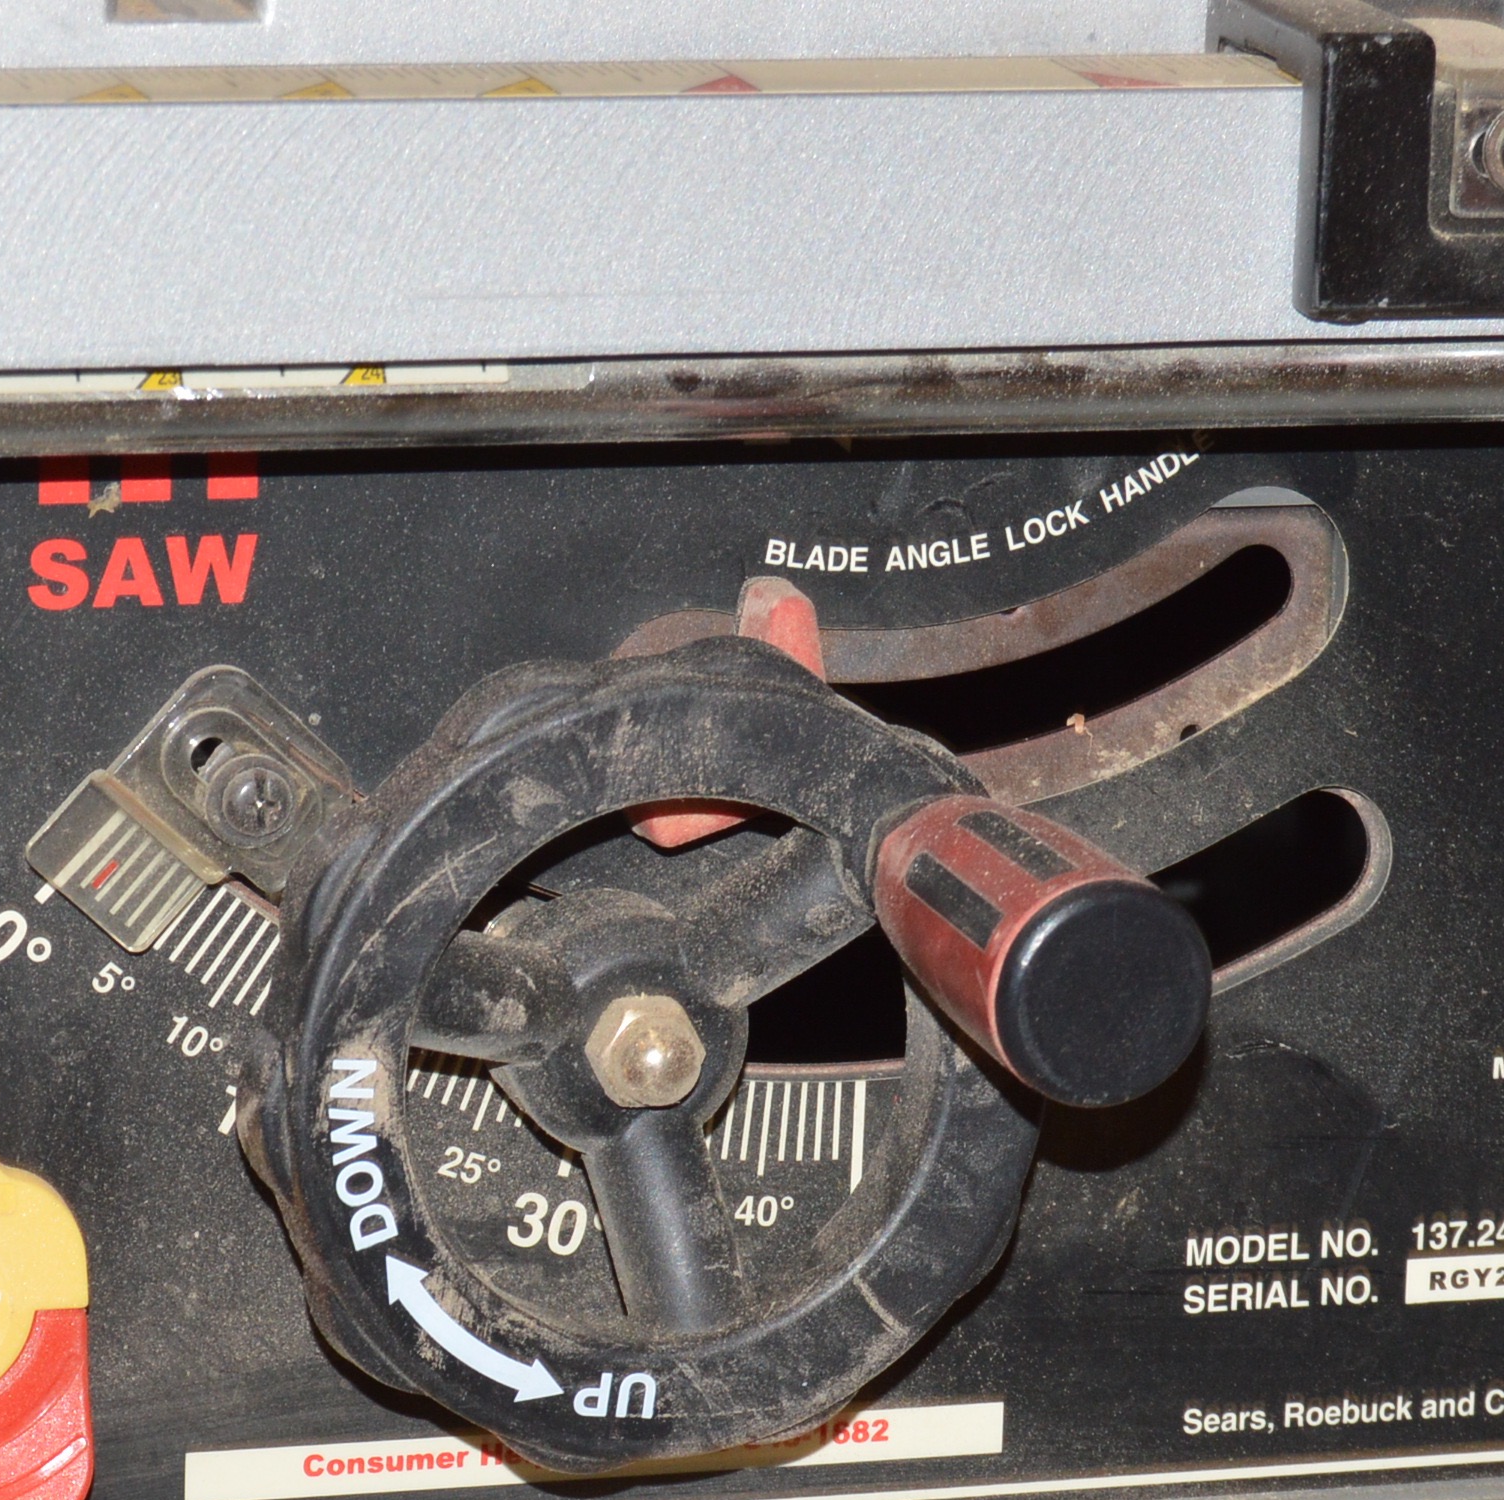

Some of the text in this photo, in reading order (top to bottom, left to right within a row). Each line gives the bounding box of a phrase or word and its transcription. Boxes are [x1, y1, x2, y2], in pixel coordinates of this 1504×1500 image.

[158, 369, 179, 386] 23
[361, 366, 381, 381] 24
[765, 538, 868, 572] BLADE
[885, 534, 991, 572] ANGLE
[1005, 500, 1090, 552] LOCK
[27, 534, 259, 611] SAW
[328, 1059, 397, 1251] DOWN
[507, 1192, 602, 1255] 30
[1185, 1232, 1310, 1267] MODEL
[1320, 1227, 1379, 1259] NO.
[1183, 1280, 1310, 1315] SERIAL
[1320, 1275, 1379, 1305] NO.
[573, 1372, 656, 1419] UP
[1182, 1406, 1275, 1436] Sears,
[1283, 1395, 1412, 1428] Roebuck
[1421, 1394, 1474, 1420] and
[303, 1449, 469, 1477] Consumer
